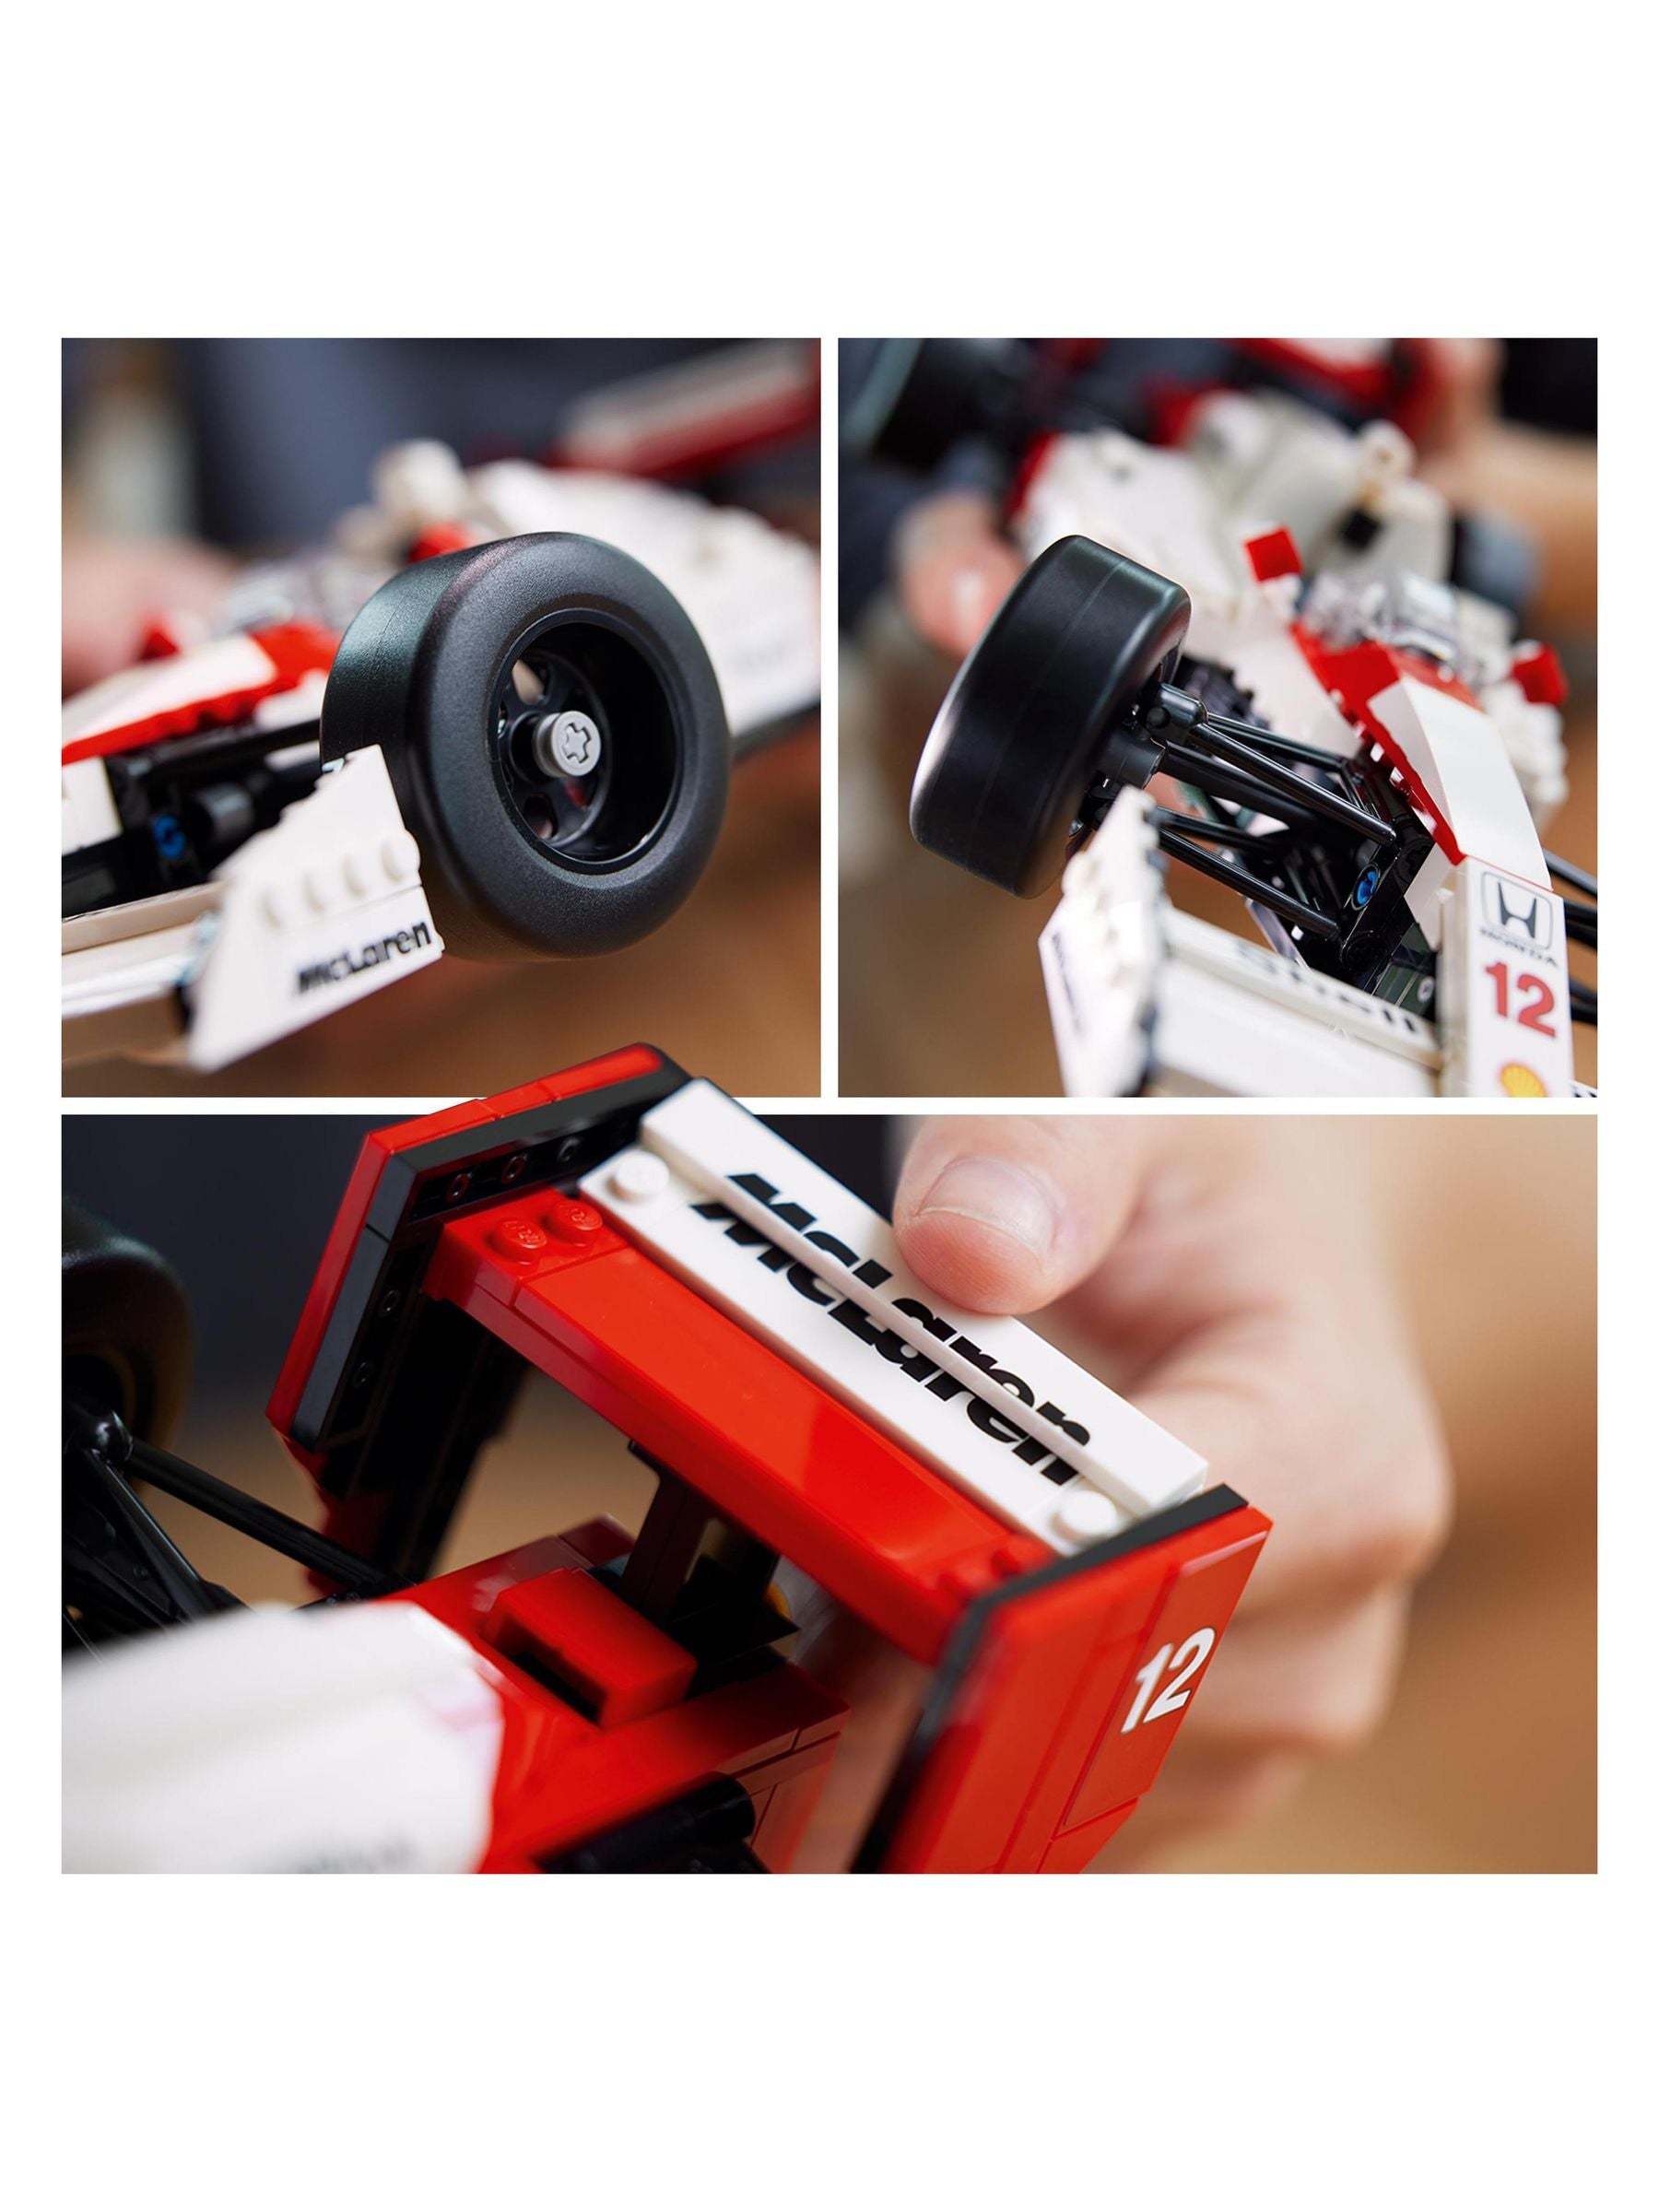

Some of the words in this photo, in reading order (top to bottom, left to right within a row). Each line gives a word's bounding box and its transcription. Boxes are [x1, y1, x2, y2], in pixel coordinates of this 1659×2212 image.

[1479, 926, 1559, 968] HONDA
[1485, 961, 1557, 1039] 12
[690, 1172, 1091, 1486] McLaren
[1120, 1627, 1216, 1734] 12
